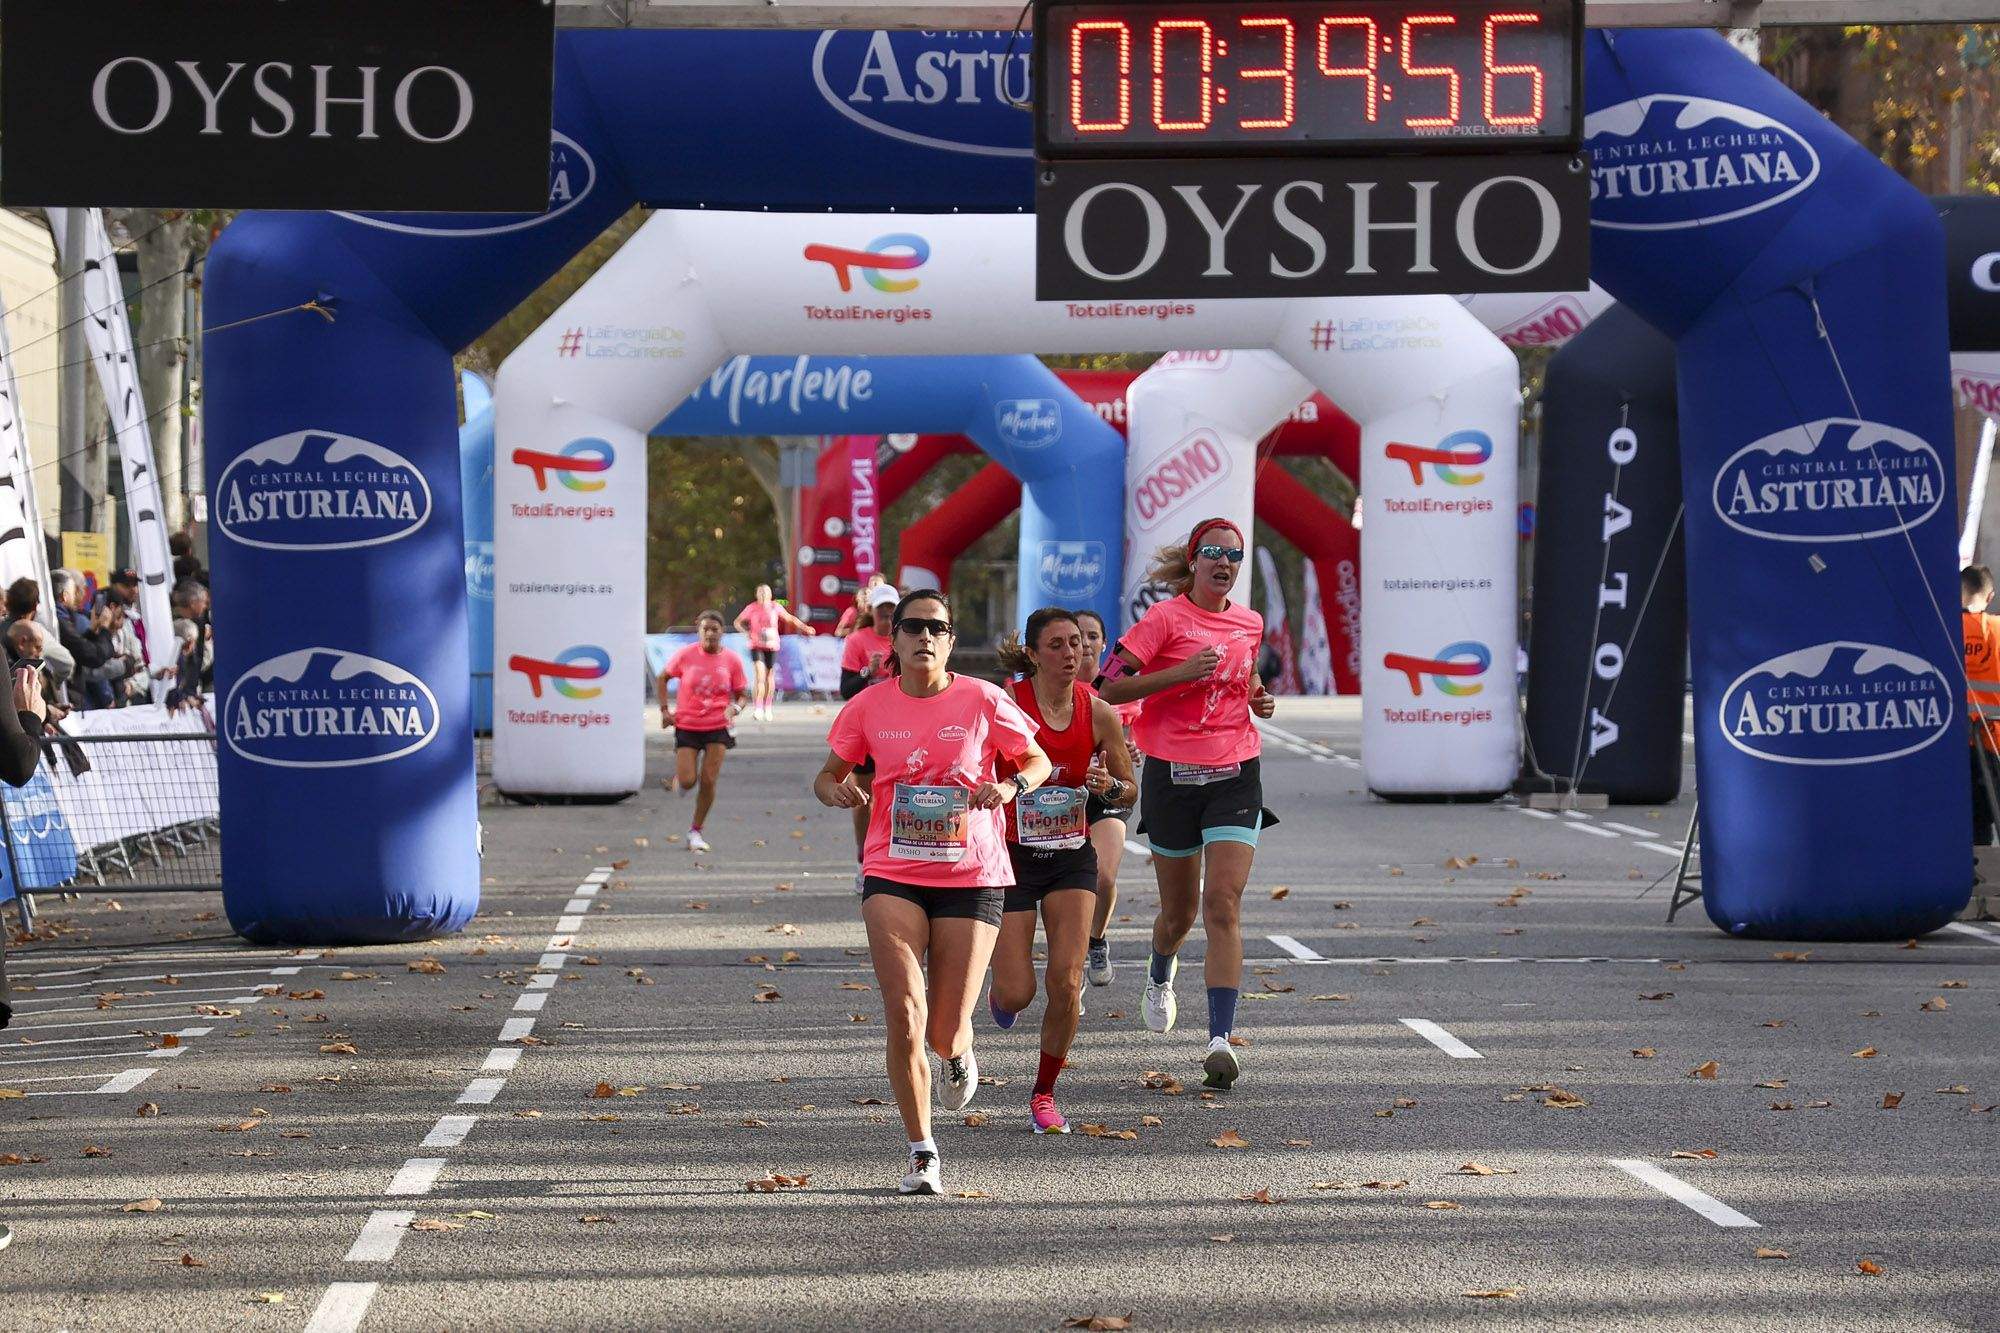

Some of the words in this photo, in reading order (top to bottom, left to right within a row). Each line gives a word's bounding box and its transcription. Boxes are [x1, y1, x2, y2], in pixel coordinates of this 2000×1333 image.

[1070, 14, 1543, 132] 00:39:56
[92, 56, 474, 144] OYSHO
[1414, 125, 1540, 136] WWW.PIXELCOM.ES
[1594, 140, 1677, 160] ENTRAL
[1687, 132, 1784, 151] LECHERA
[1063, 176, 1562, 282] OYSHO
[804, 304, 932, 323] TotalEnergies
[1066, 302, 1195, 322] TotalEnergies
[1763, 461, 1848, 476] CENTRAL
[1856, 457, 1929, 471] LECHERA
[250, 471, 324, 485] CENTRAL
[333, 471, 410, 484] LECHERA
[1135, 439, 1221, 520] COSMO
[225, 479, 418, 524] ASTURIANA
[1728, 469, 1935, 515] ASTURIANA
[511, 503, 615, 521] TotalEnergies
[1384, 498, 1493, 516] TotalEnergies
[509, 582, 613, 596] totalenergies.es
[1384, 577, 1492, 592] totalenergies.es
[1589, 427, 1638, 757] VOLVO
[257, 689, 330, 702] CENTRAL
[339, 688, 417, 701] LECHERA
[1768, 684, 1856, 700] CENTRAL
[1862, 680, 1936, 695] LECHERA
[233, 695, 426, 740] ASTURIANA
[507, 709, 611, 728] TotalEnergies
[1384, 708, 1492, 726] TotalEnergies
[1734, 690, 1943, 737] ASTURIANA
[878, 730, 911, 739] OYSHO
